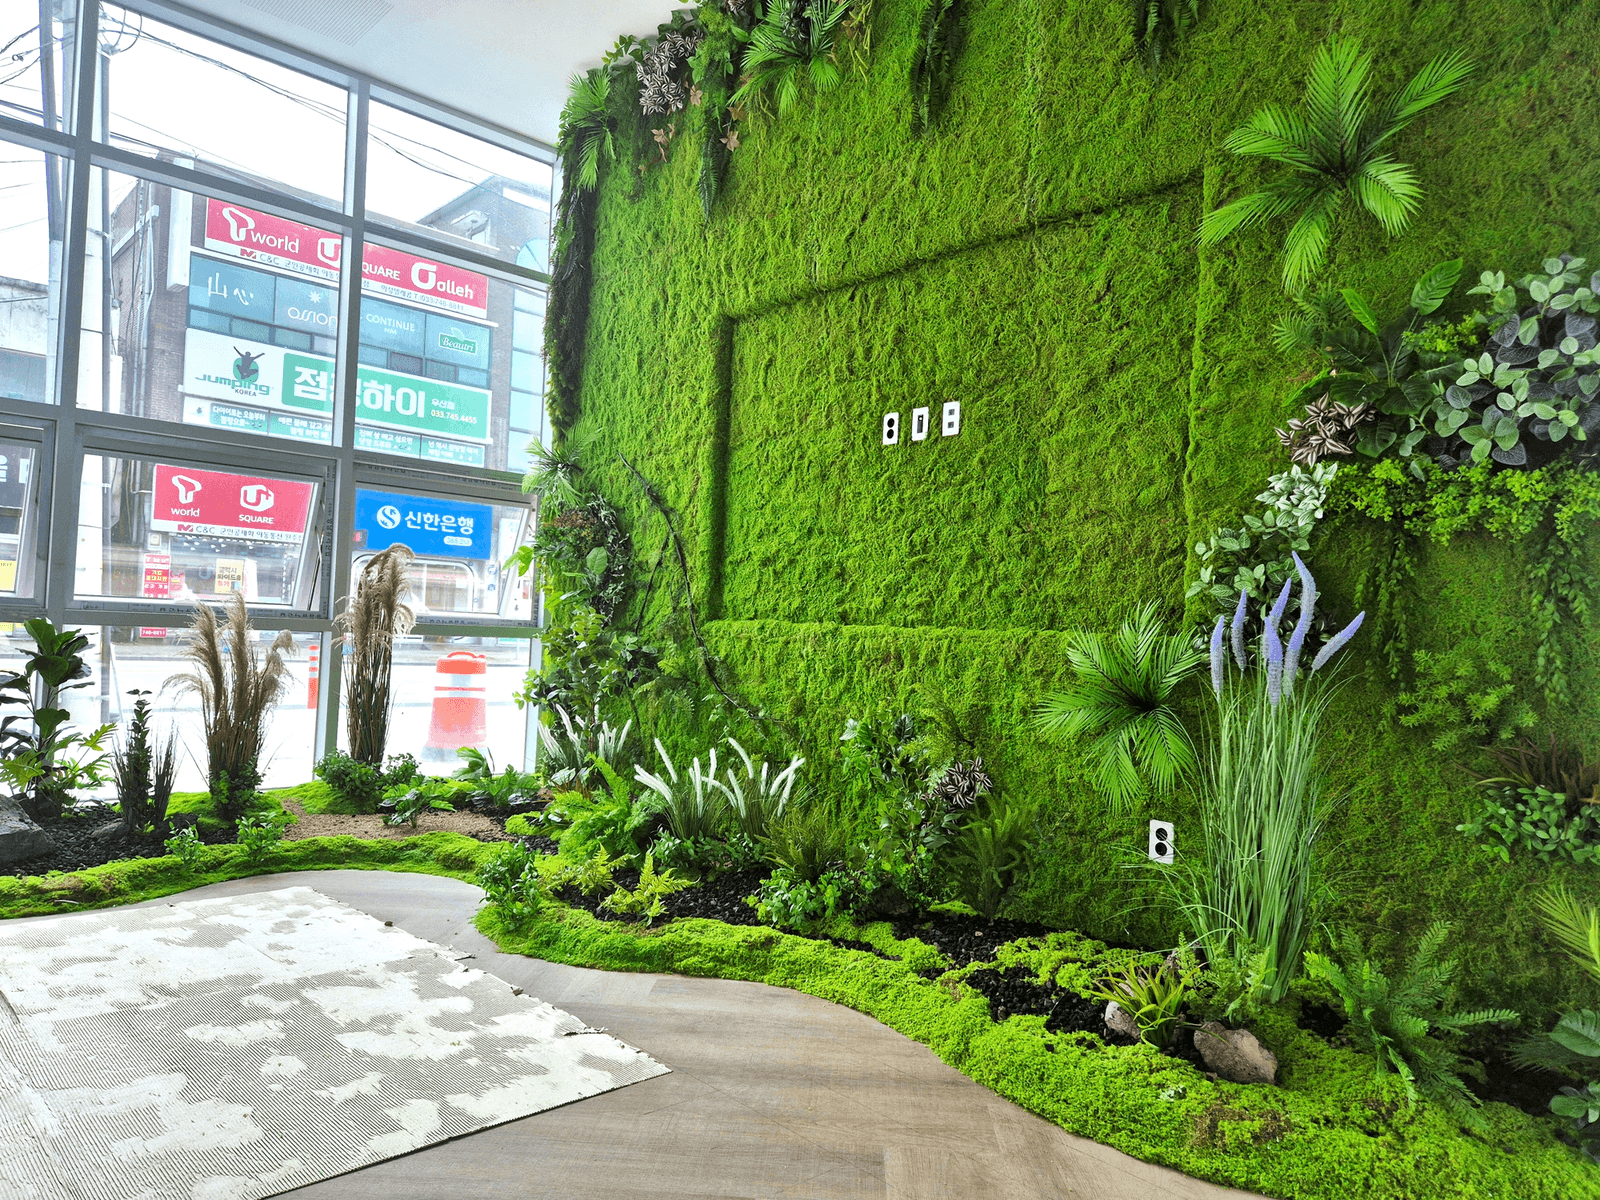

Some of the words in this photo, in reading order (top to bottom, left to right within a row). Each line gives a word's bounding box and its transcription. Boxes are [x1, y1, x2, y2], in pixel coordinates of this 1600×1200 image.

[251, 230, 299, 253] world
[362, 261, 400, 280] QUARE
[366, 313, 416, 332] CONTINUE
[234, 388, 257, 397] KOREA
[171, 508, 200, 517] world
[239, 514, 275, 525] SQUARE
[195, 526, 216, 534] C&C
[404, 511, 474, 535] 신한은행
